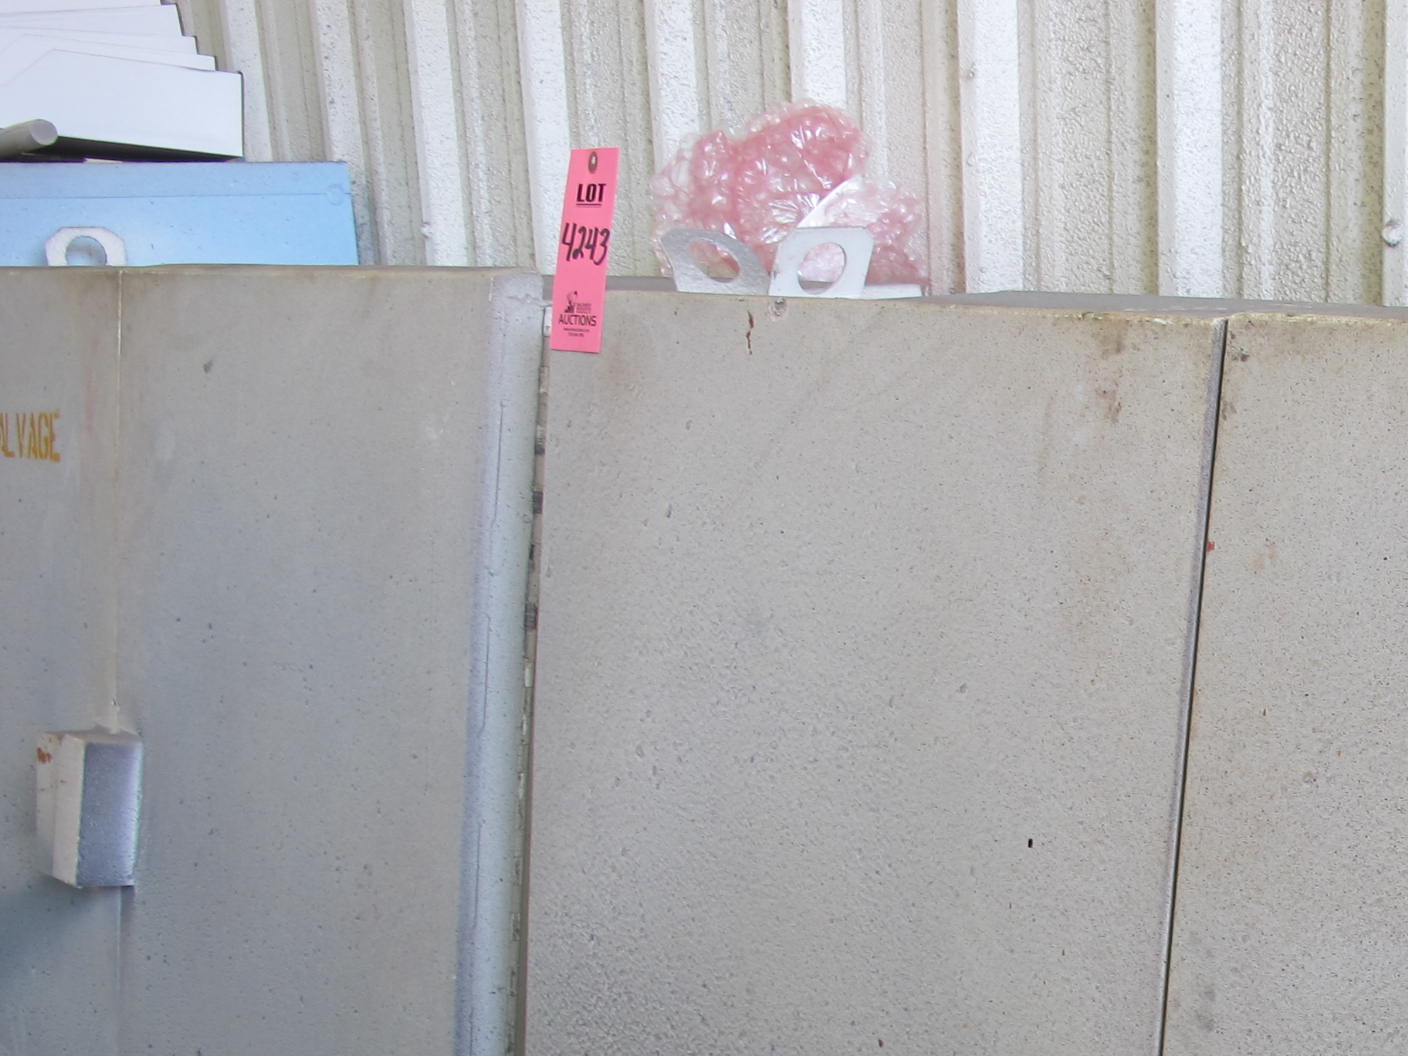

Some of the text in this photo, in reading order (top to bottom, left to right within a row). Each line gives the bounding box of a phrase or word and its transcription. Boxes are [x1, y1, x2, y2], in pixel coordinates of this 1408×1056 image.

[576, 183, 606, 203] LOT
[562, 222, 611, 266] 4243
[558, 313, 597, 327] AUCTIONS
